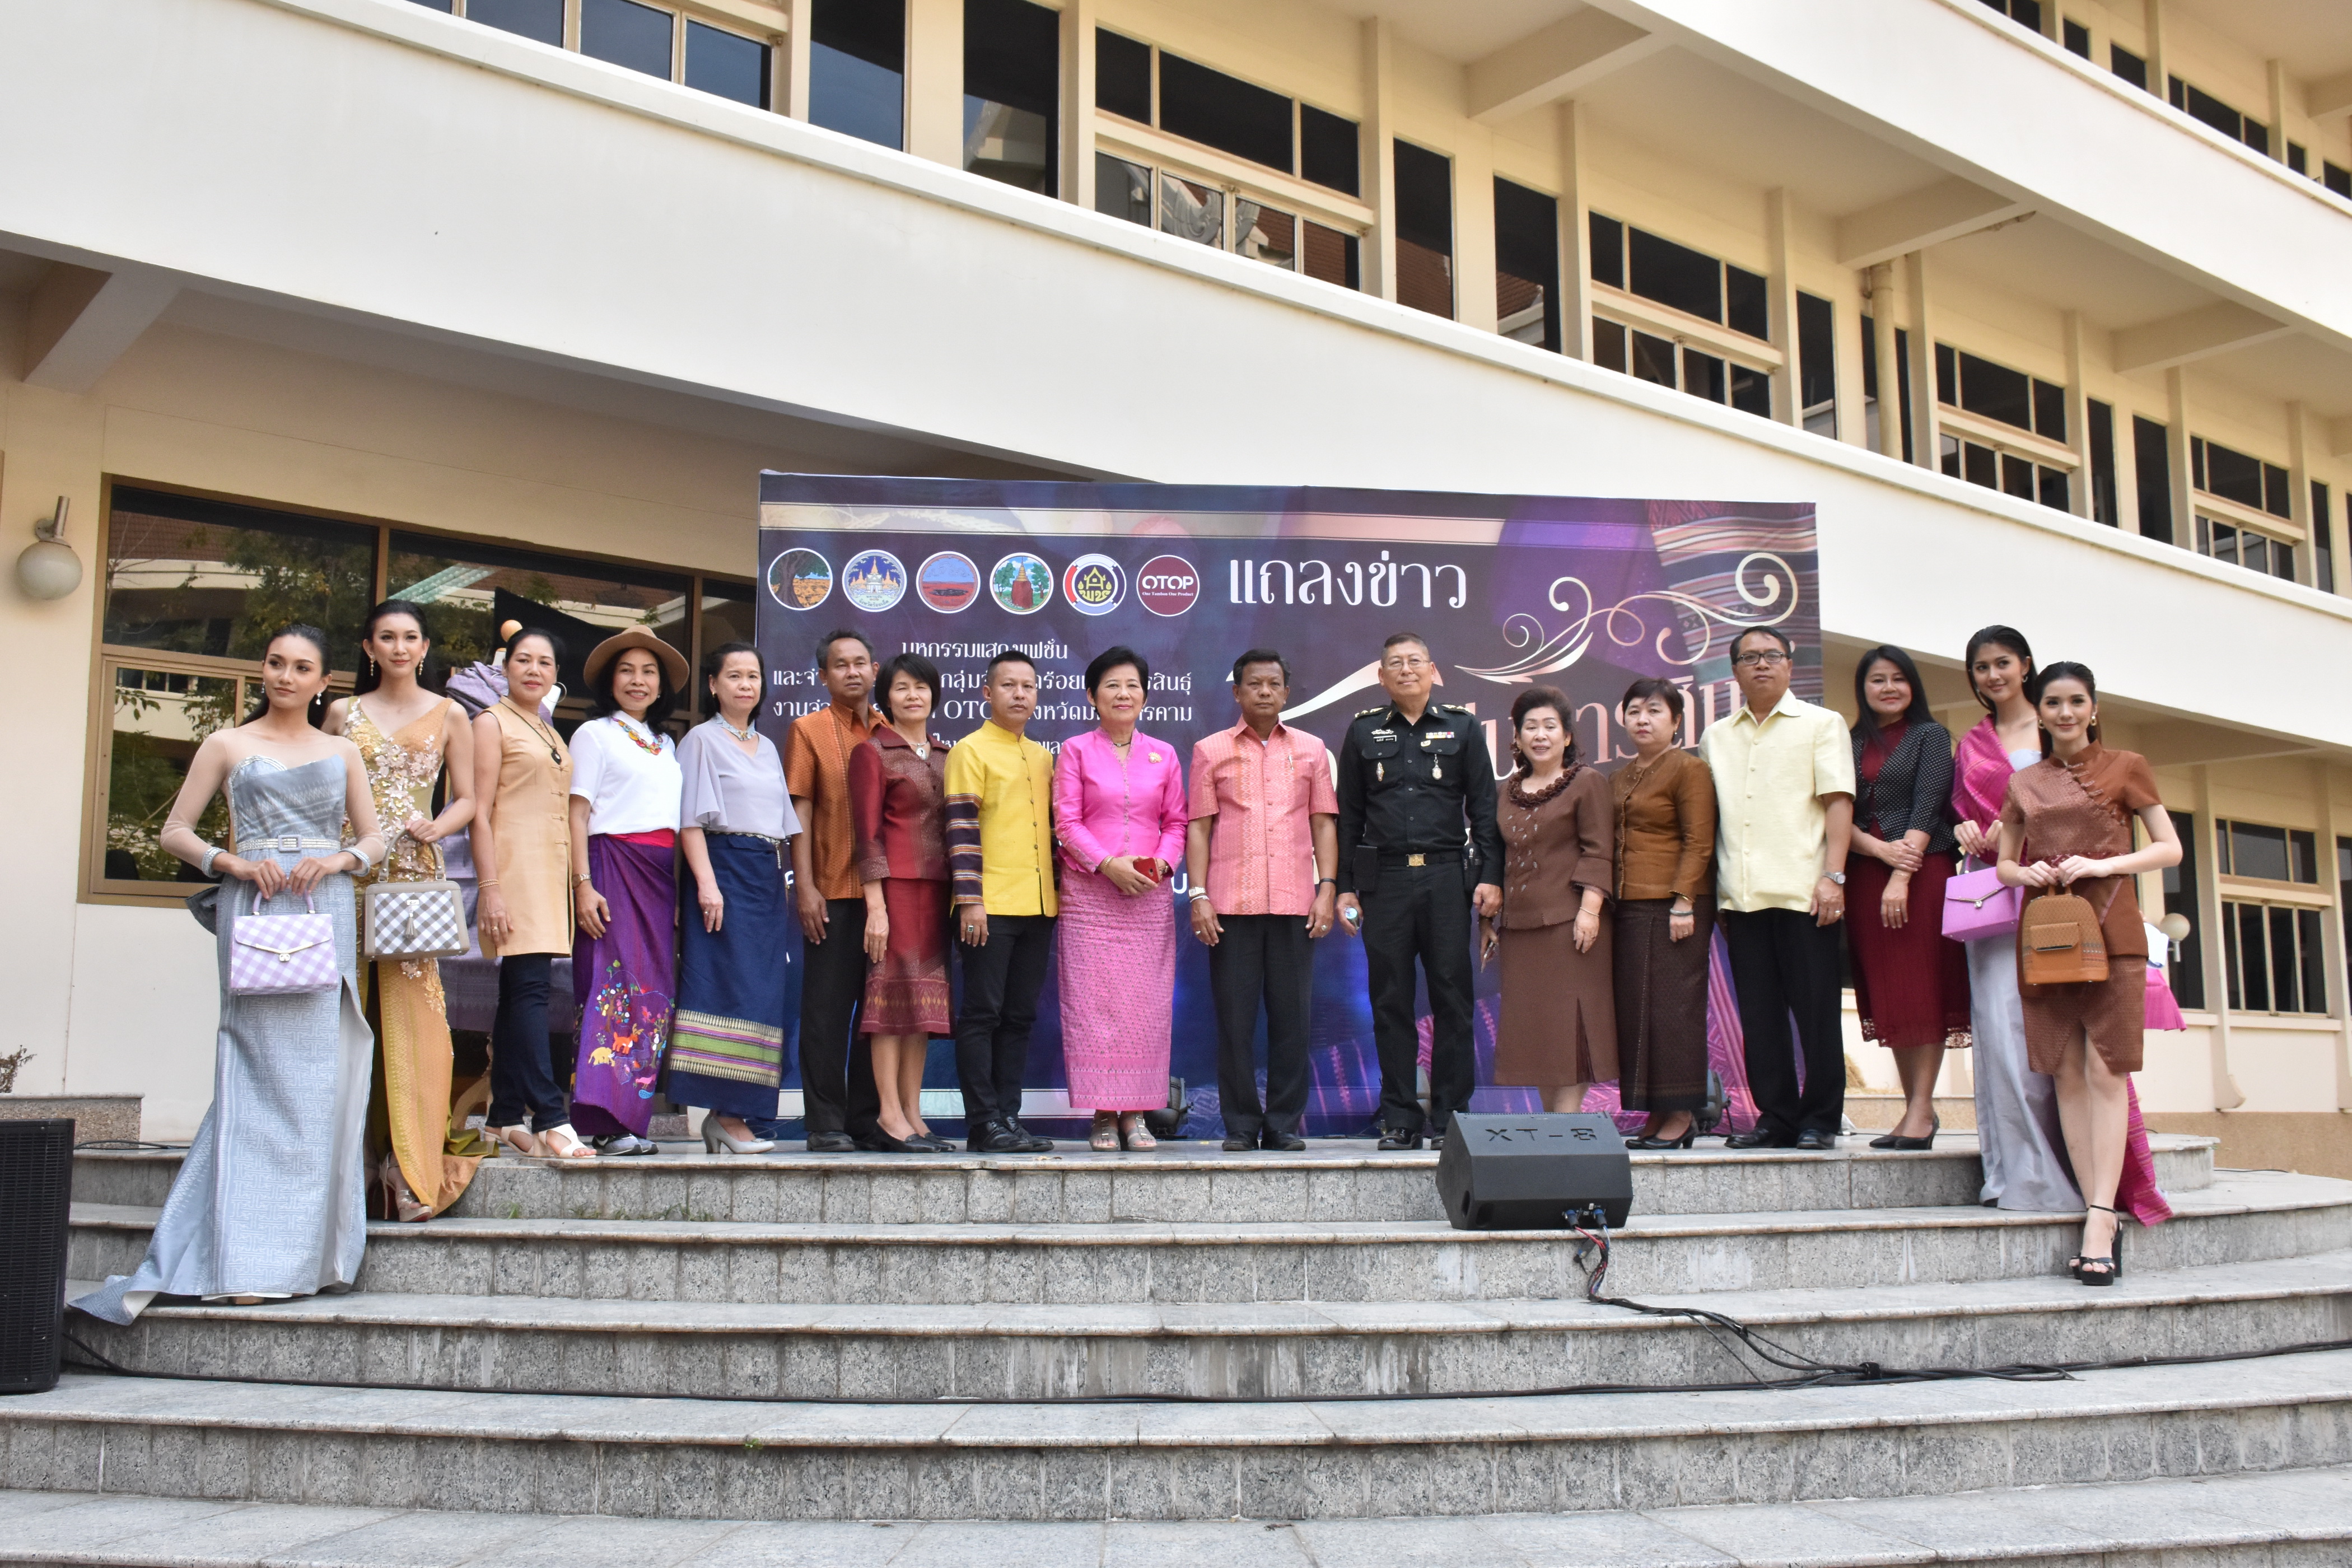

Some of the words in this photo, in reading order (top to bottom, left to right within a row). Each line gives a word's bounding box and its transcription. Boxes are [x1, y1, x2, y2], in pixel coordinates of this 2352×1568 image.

[1142, 575, 1194, 589] OTOP
[1230, 550, 1467, 608] แถลงข่าว
[944, 700, 992, 720] OTO
